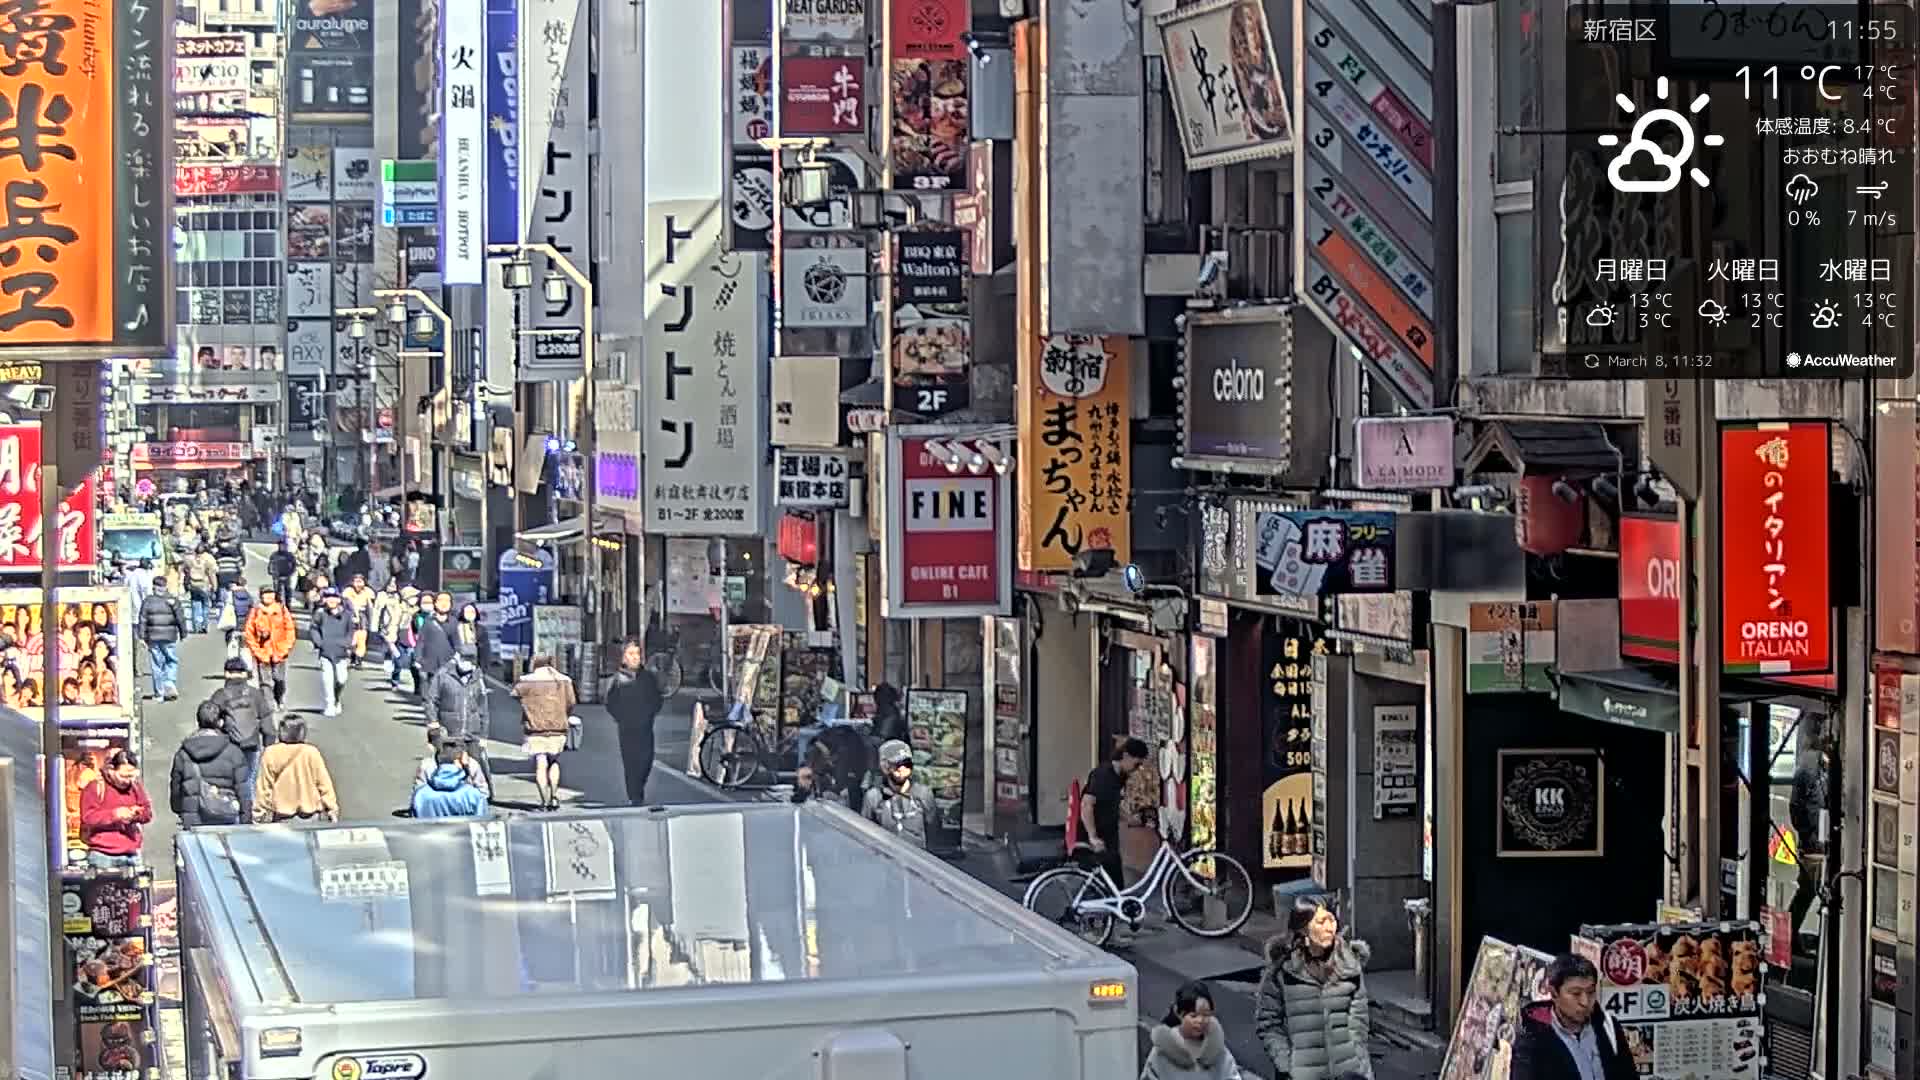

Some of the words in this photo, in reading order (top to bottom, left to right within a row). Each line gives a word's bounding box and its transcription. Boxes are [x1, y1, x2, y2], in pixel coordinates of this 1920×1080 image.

[816, 0, 863, 14] GARDEN
[1314, 27, 1336, 49] 5
[450, 44, 475, 110] 火鍋
[1314, 79, 1334, 97] 4
[1356, 122, 1414, 185] センチュリー
[1314, 126, 1335, 149] 3
[1313, 176, 1335, 199] 2
[1317, 227, 1333, 246] 1
[901, 262, 961, 277] Walton's
[1311, 273, 1340, 304] B1
[661, 214, 693, 470] トントン
[1212, 357, 1265, 402] celona
[916, 389, 949, 412] 2F
[1041, 401, 1085, 556] まっちゃん
[911, 490, 988, 520] FINE
[1349, 525, 1392, 541] フリー
[1754, 435, 1791, 610] 俺のイタリアン
[910, 565, 955, 582] ONLINE
[958, 565, 989, 581] CAFE
[1741, 620, 1809, 639] ORENO
[1740, 638, 1810, 657] ITALIAN
[1604, 991, 1639, 1016] 4F
